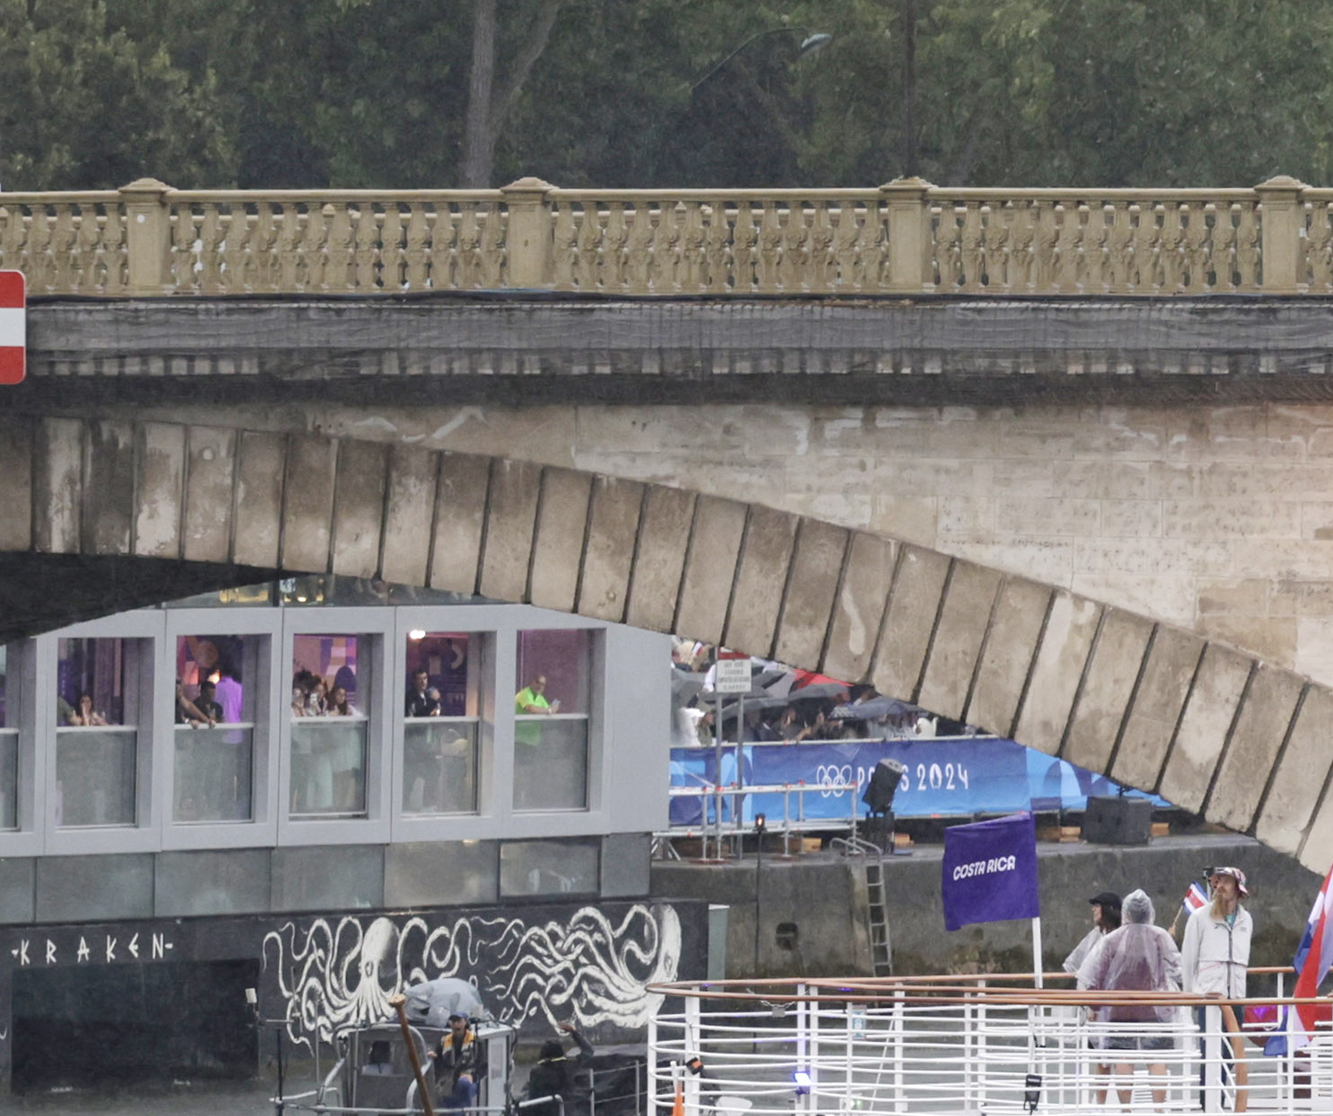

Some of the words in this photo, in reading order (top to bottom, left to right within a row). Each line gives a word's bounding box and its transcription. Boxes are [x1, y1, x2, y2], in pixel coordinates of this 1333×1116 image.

[916, 763, 969, 791] 2024
[953, 861, 986, 881] COSTA
[986, 855, 1016, 873] RICA
